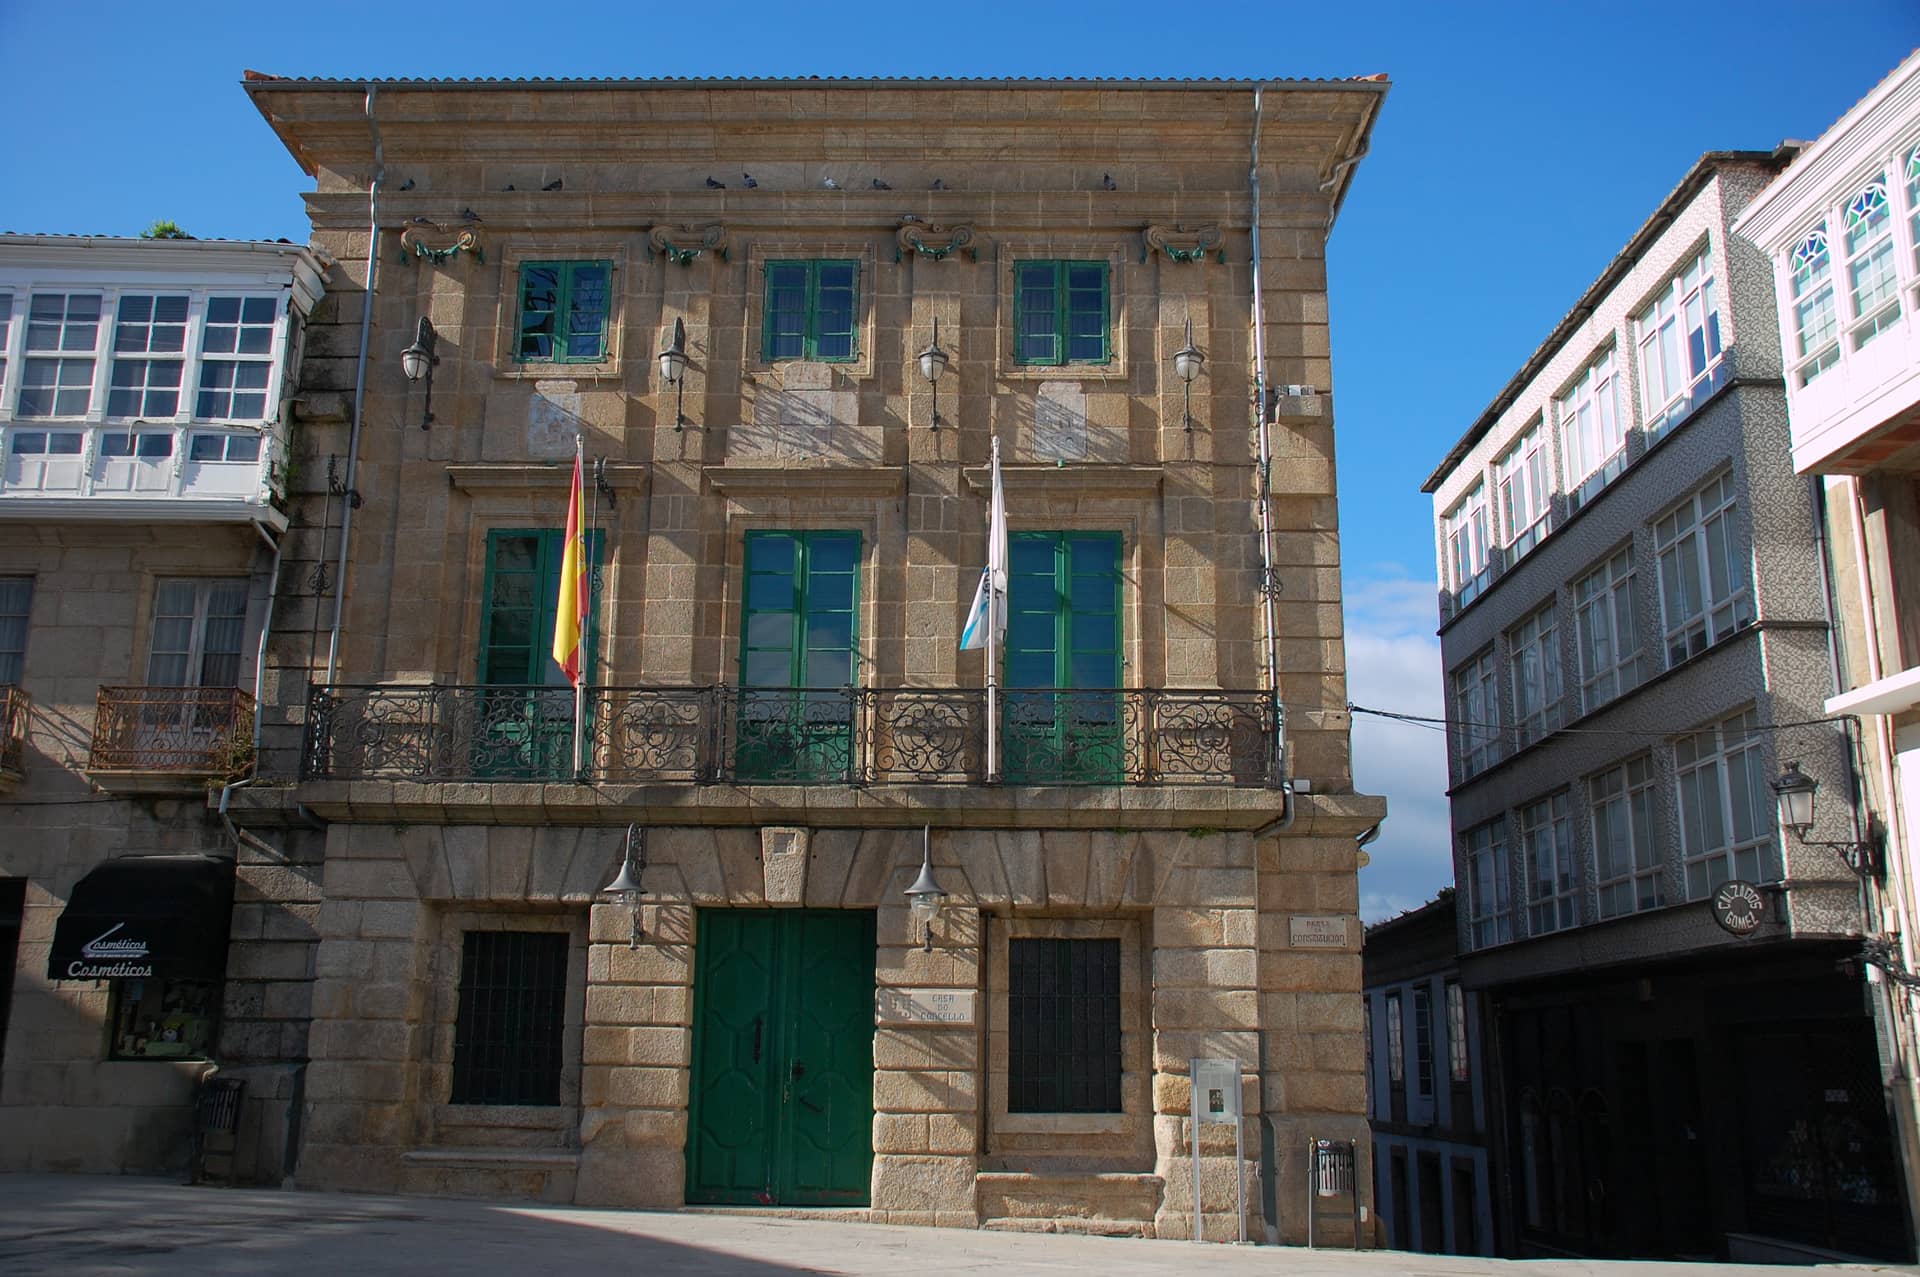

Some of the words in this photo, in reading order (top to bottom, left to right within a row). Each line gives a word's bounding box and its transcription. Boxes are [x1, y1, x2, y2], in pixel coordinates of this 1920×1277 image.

[1725, 911, 1759, 929] GOMEZ
[68, 961, 152, 977] Cosméticos
[932, 994, 954, 1003] CASA
[937, 1004, 949, 1012] DO
[920, 1012, 965, 1021] CONCELLO
